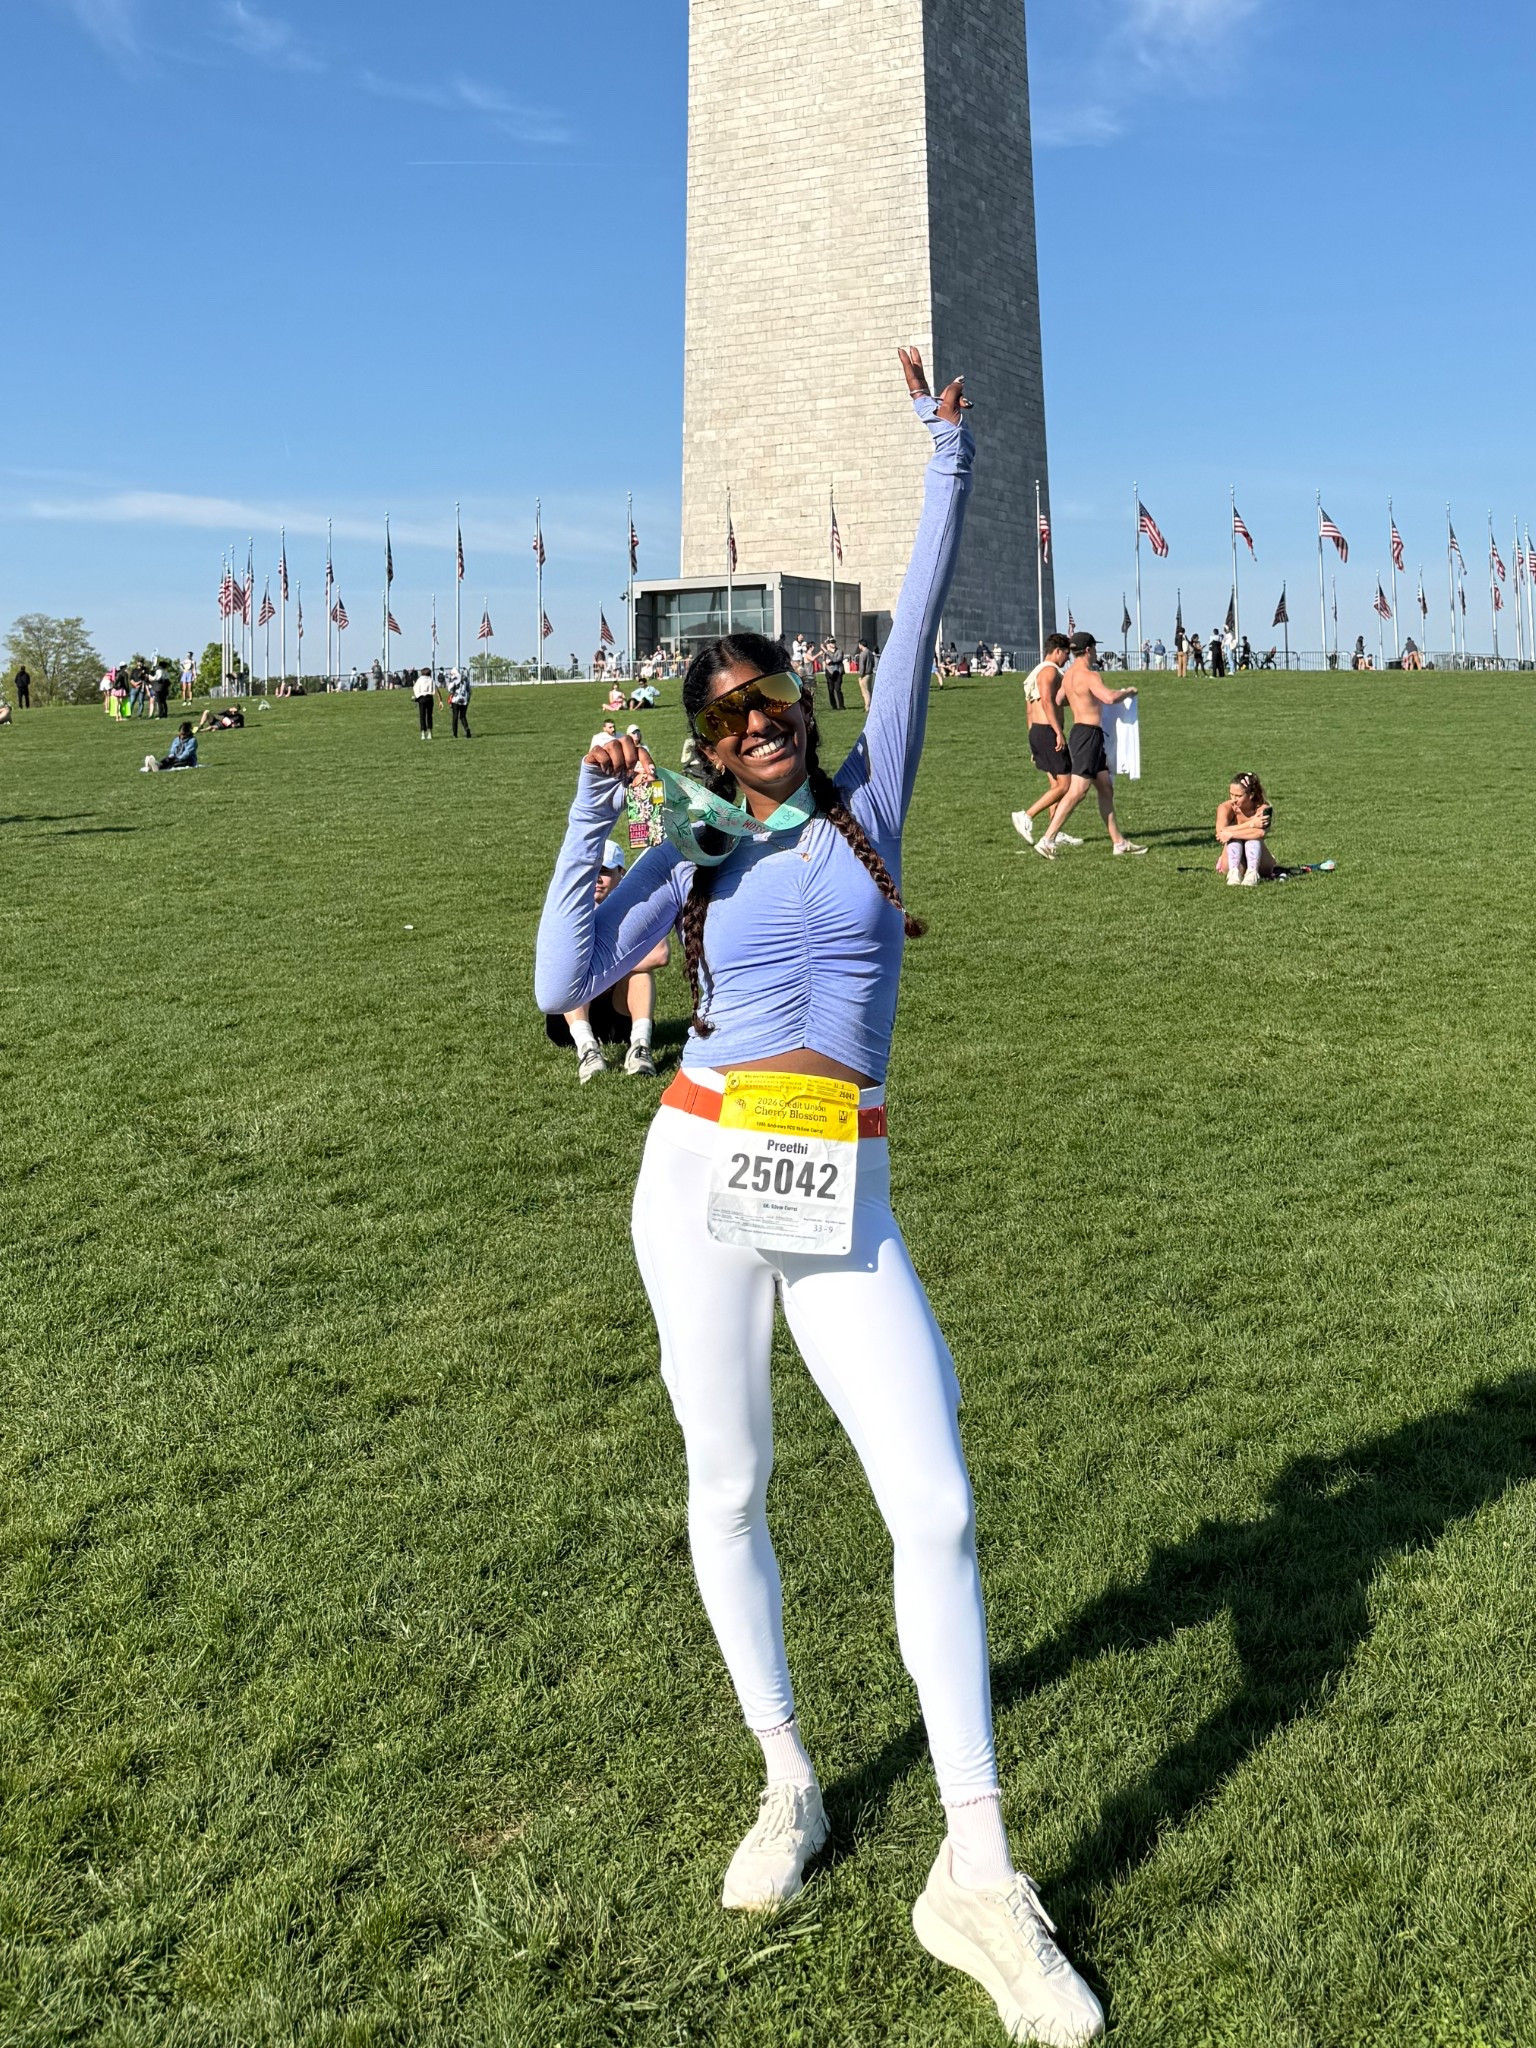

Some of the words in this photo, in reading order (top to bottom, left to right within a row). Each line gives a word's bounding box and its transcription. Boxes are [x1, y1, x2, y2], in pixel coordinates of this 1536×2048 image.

[783, 810, 795, 822] DC
[757, 1097, 778, 1106] 2026
[779, 1099, 803, 1109] Credit
[804, 1102, 826, 1112] Union
[754, 1106, 787, 1119] Cherry
[789, 1110, 828, 1122] Blossom
[767, 1139, 809, 1155] Preethi
[728, 1153, 838, 1200] 25042
